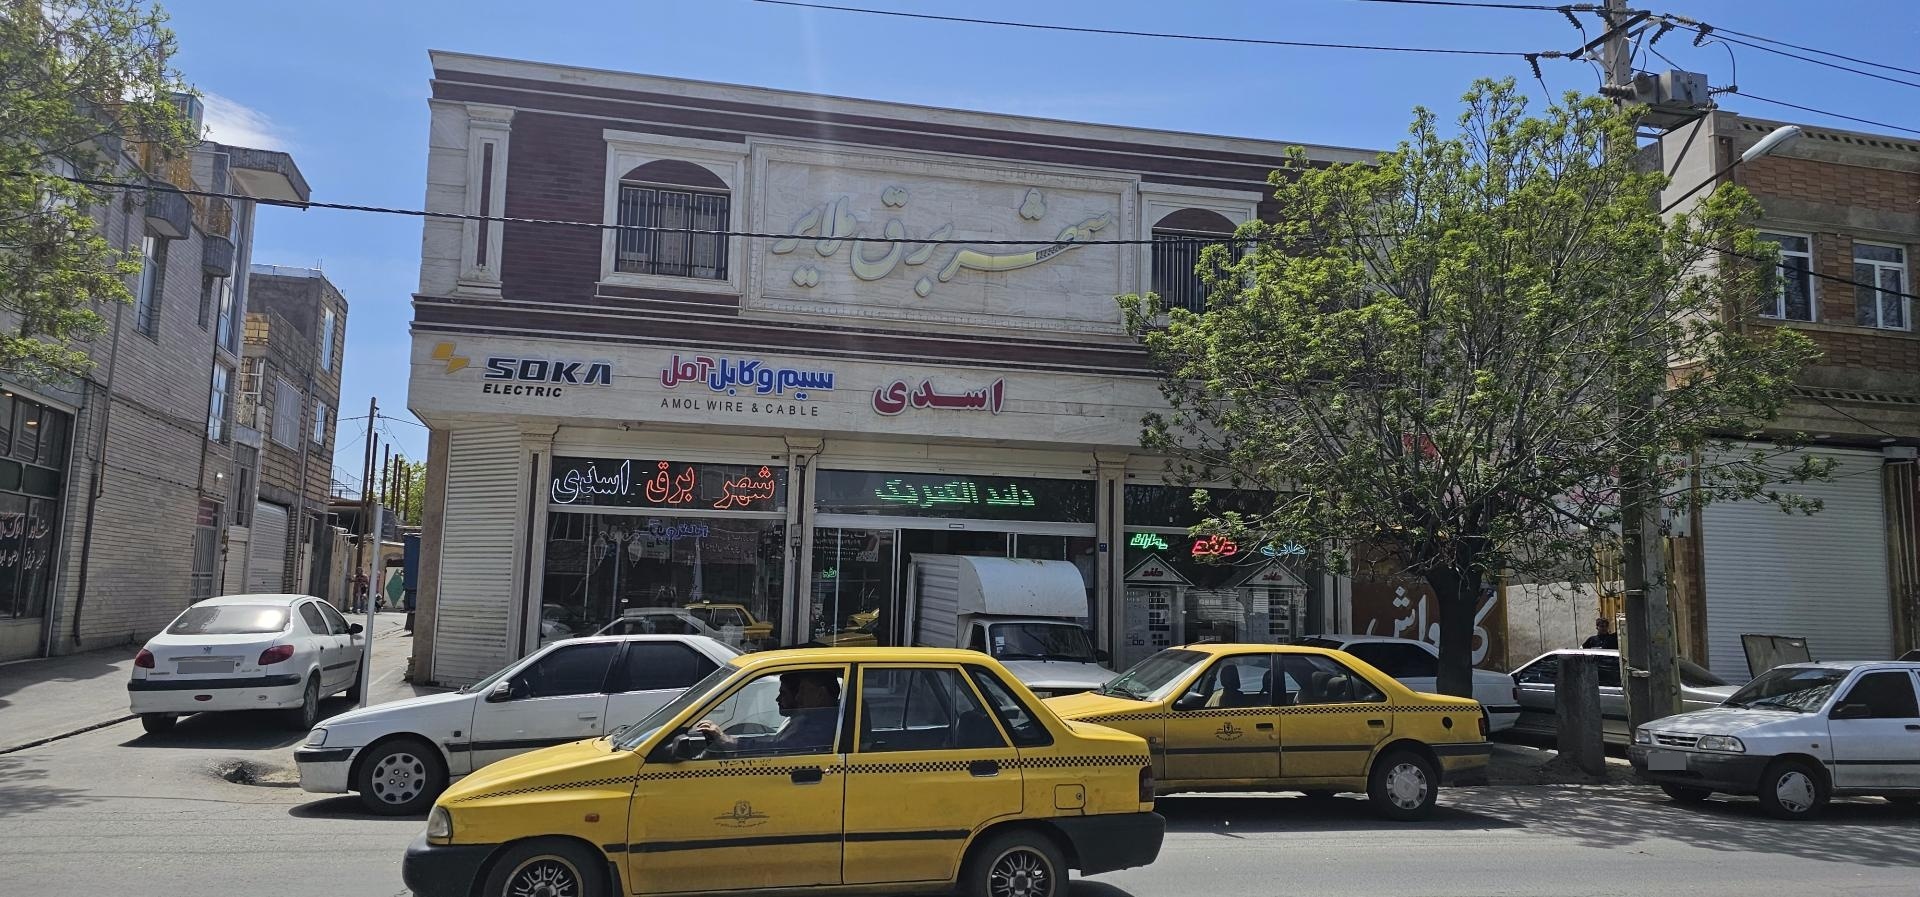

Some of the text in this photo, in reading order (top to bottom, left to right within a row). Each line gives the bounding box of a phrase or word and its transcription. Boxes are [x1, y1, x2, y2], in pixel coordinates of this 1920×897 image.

[850, 185, 954, 298] برق
[483, 357, 612, 385] SOKA
[661, 354, 835, 400] سیم و کابل آمل
[483, 383, 563, 398] ELECTRIC
[661, 398, 818, 416] AMOL WIRE & CABLE
[872, 377, 1005, 415] اسدی
[551, 459, 775, 509] شهر برق اسدی
[874, 479, 1036, 508] دلند الکتریک
